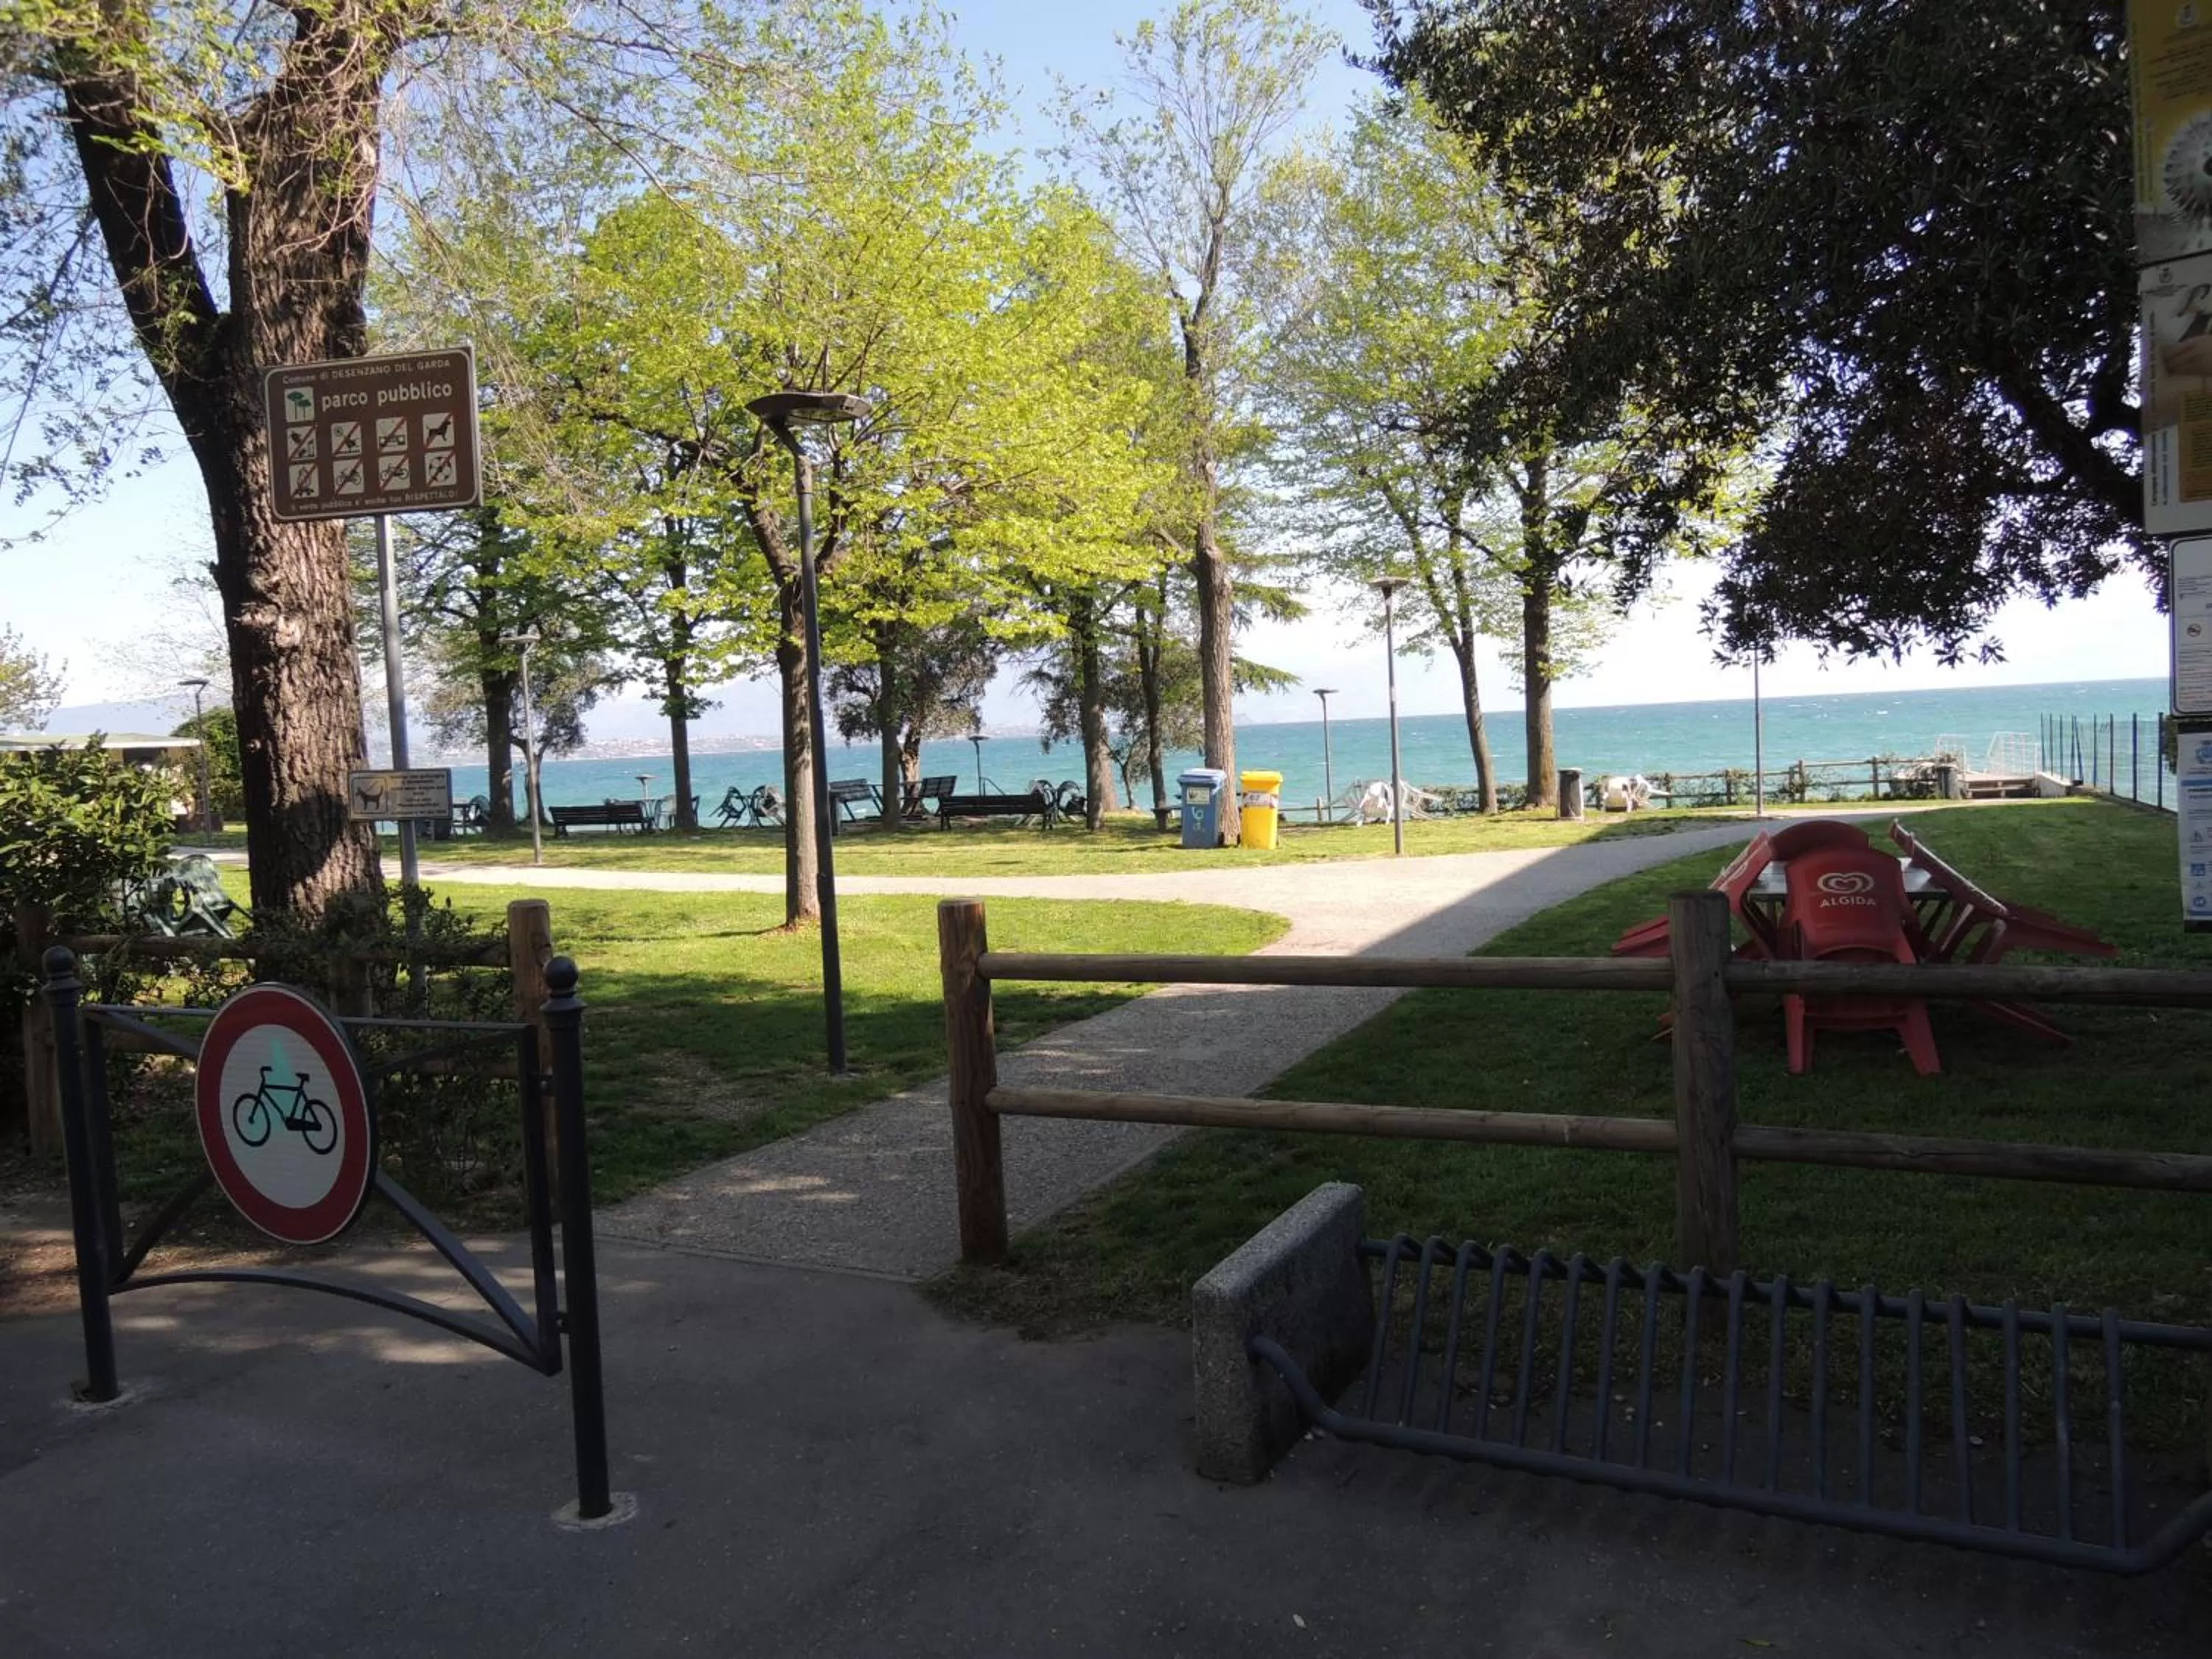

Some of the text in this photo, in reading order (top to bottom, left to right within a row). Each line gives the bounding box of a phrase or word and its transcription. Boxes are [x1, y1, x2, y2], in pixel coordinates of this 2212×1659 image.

[282, 358, 451, 384] Comune di DESENZANO DEL GARDA
[321, 380, 453, 412] parco pubblico
[1819, 896, 1876, 908] ALGIDA
